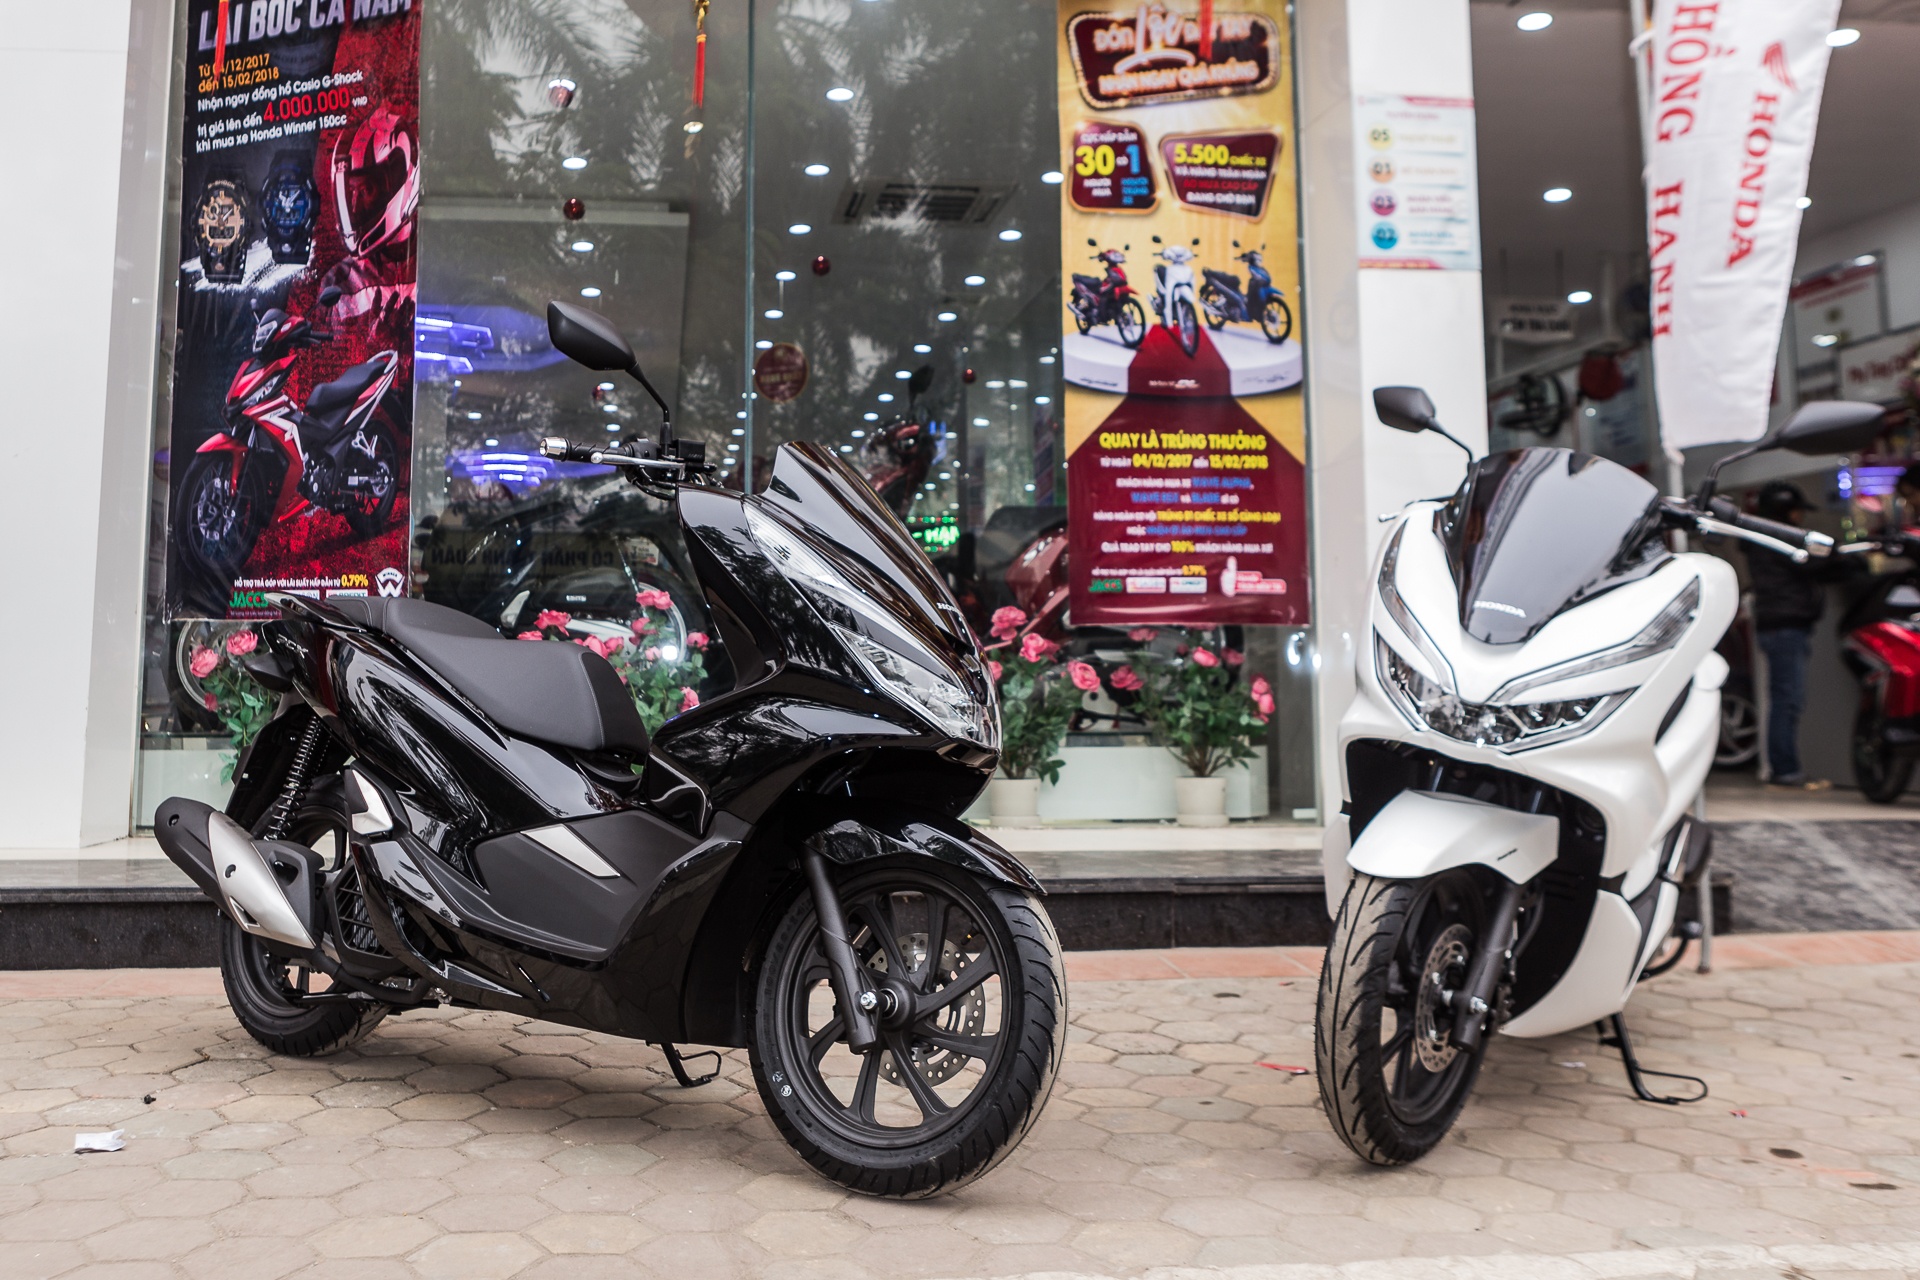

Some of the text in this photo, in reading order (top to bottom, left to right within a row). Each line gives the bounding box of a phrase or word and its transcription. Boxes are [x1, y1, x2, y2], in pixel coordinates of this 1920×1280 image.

[223, 67, 279, 89] 15/02/2018
[198, 69, 363, 112] Nhận ngay đồng hồ Casio G-Shock
[198, 124, 207, 138] trị
[210, 120, 224, 138] giá
[226, 117, 241, 130] lên
[243, 112, 262, 128] đến
[264, 88, 350, 123] 4.000.000
[196, 115, 347, 153] khi mua xe Honda Winner 150cc
[1075, 144, 1115, 176] 30
[1126, 144, 1140, 175] 1
[1174, 142, 1229, 165] 5.500
[1726, 91, 1778, 267] HONDA
[1099, 432, 1140, 449] QUAY
[1141, 429, 1159, 448] LÀ
[1160, 429, 1207, 449] TRÚNG
[1132, 453, 1193, 469] 04/12/2017
[1209, 454, 1269, 469] 15/02/2018
[341, 574, 369, 587] 0.79%
[1088, 578, 1123, 593] JACCS
[229, 591, 269, 608] JACCS
[1473, 600, 1527, 618] HONDA
[276, 633, 309, 659] PCX
